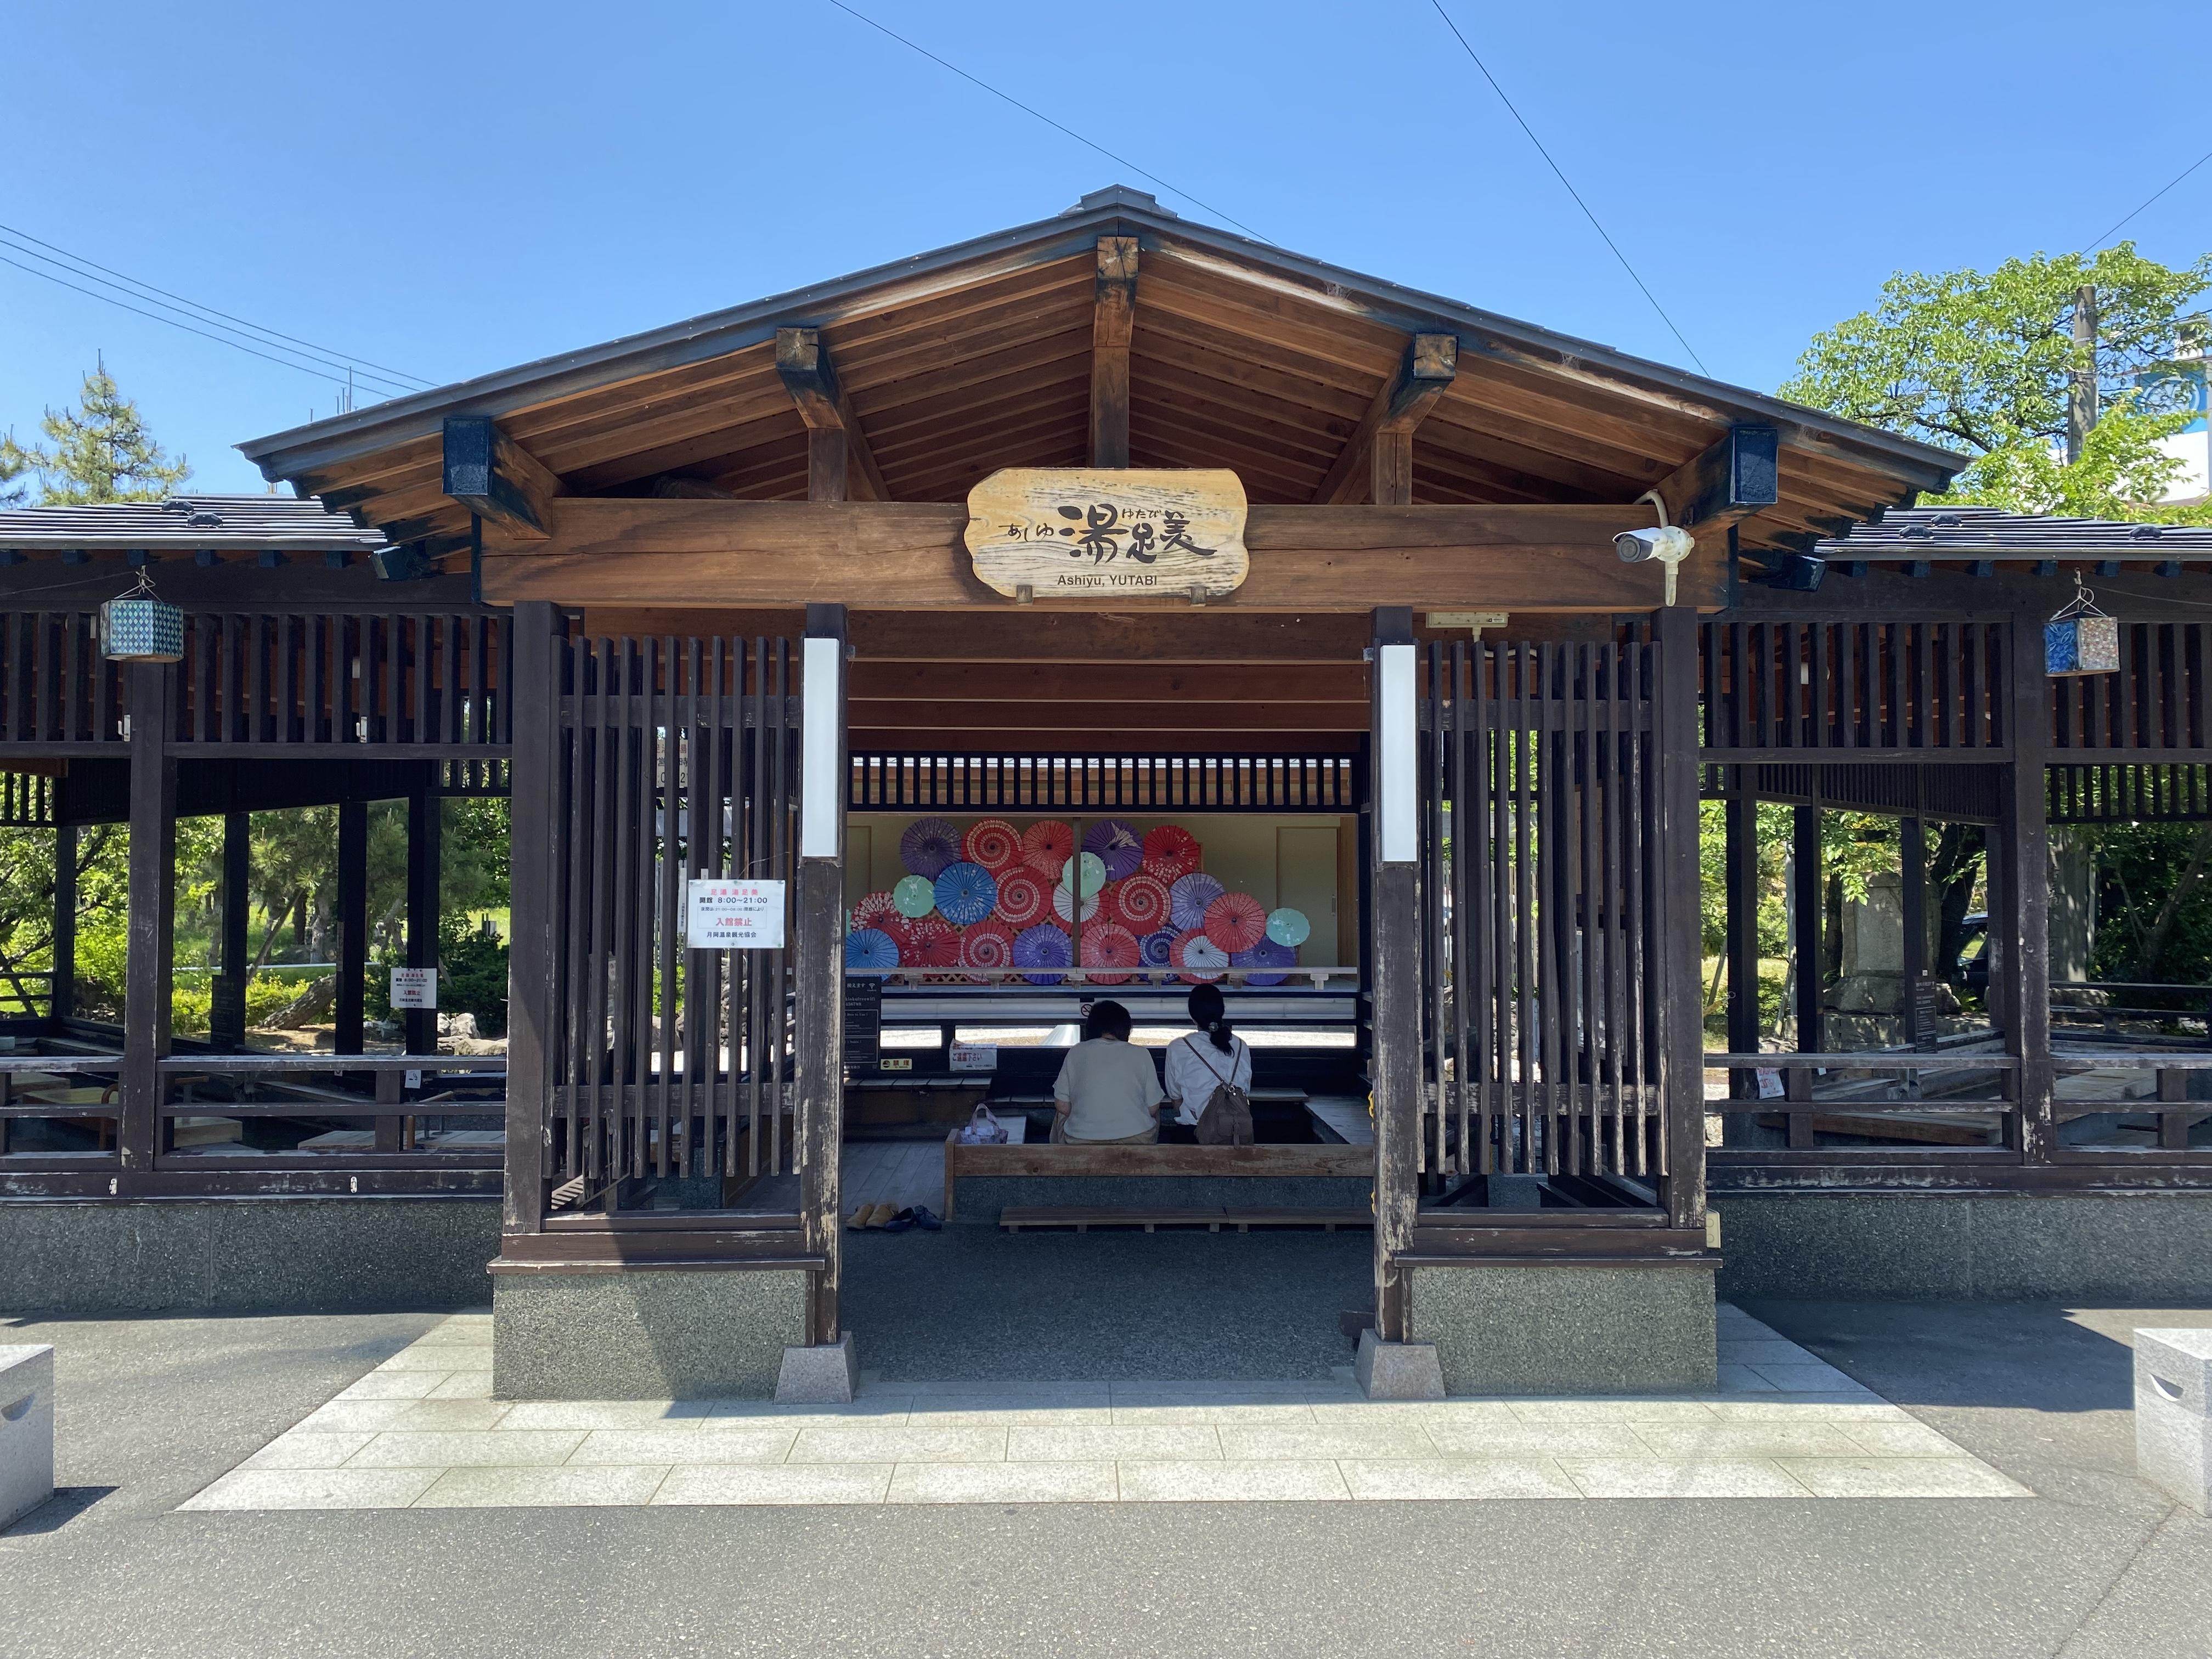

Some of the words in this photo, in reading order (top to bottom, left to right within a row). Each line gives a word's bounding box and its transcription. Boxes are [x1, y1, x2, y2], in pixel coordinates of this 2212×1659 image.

[1122, 508, 1162, 520] ゆたび
[998, 522, 1054, 542] あしゆ
[1057, 503, 1217, 566] 湯足美
[1057, 574, 1105, 588] Ashiyu,
[1109, 575, 1157, 586] YUTABI
[715, 917, 752, 926] 入館禁止
